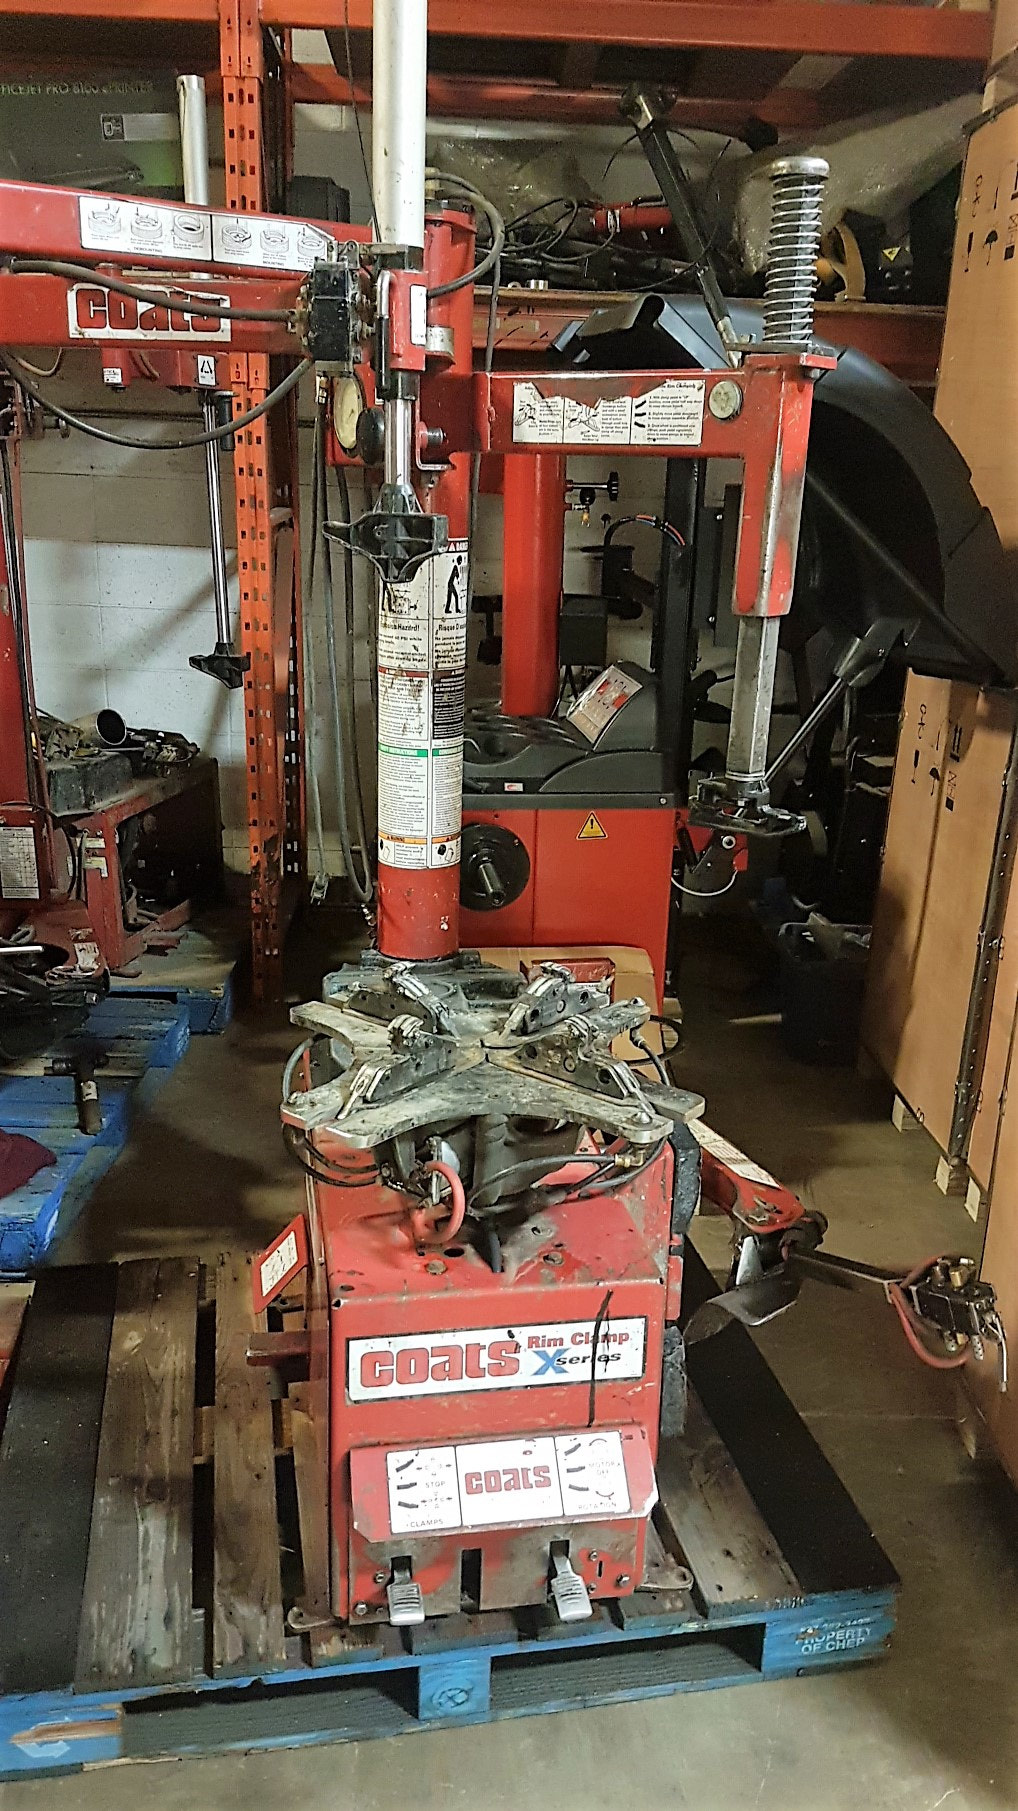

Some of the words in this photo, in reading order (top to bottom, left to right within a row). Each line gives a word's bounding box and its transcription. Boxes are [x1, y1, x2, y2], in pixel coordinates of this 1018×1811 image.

[527, 1335, 564, 1349] Rim
[425, 1481, 446, 1489] STOP
[410, 1519, 444, 1528] CLAMPS
[801, 1643, 824, 1655] OF
[825, 1637, 866, 1651] CHEP
